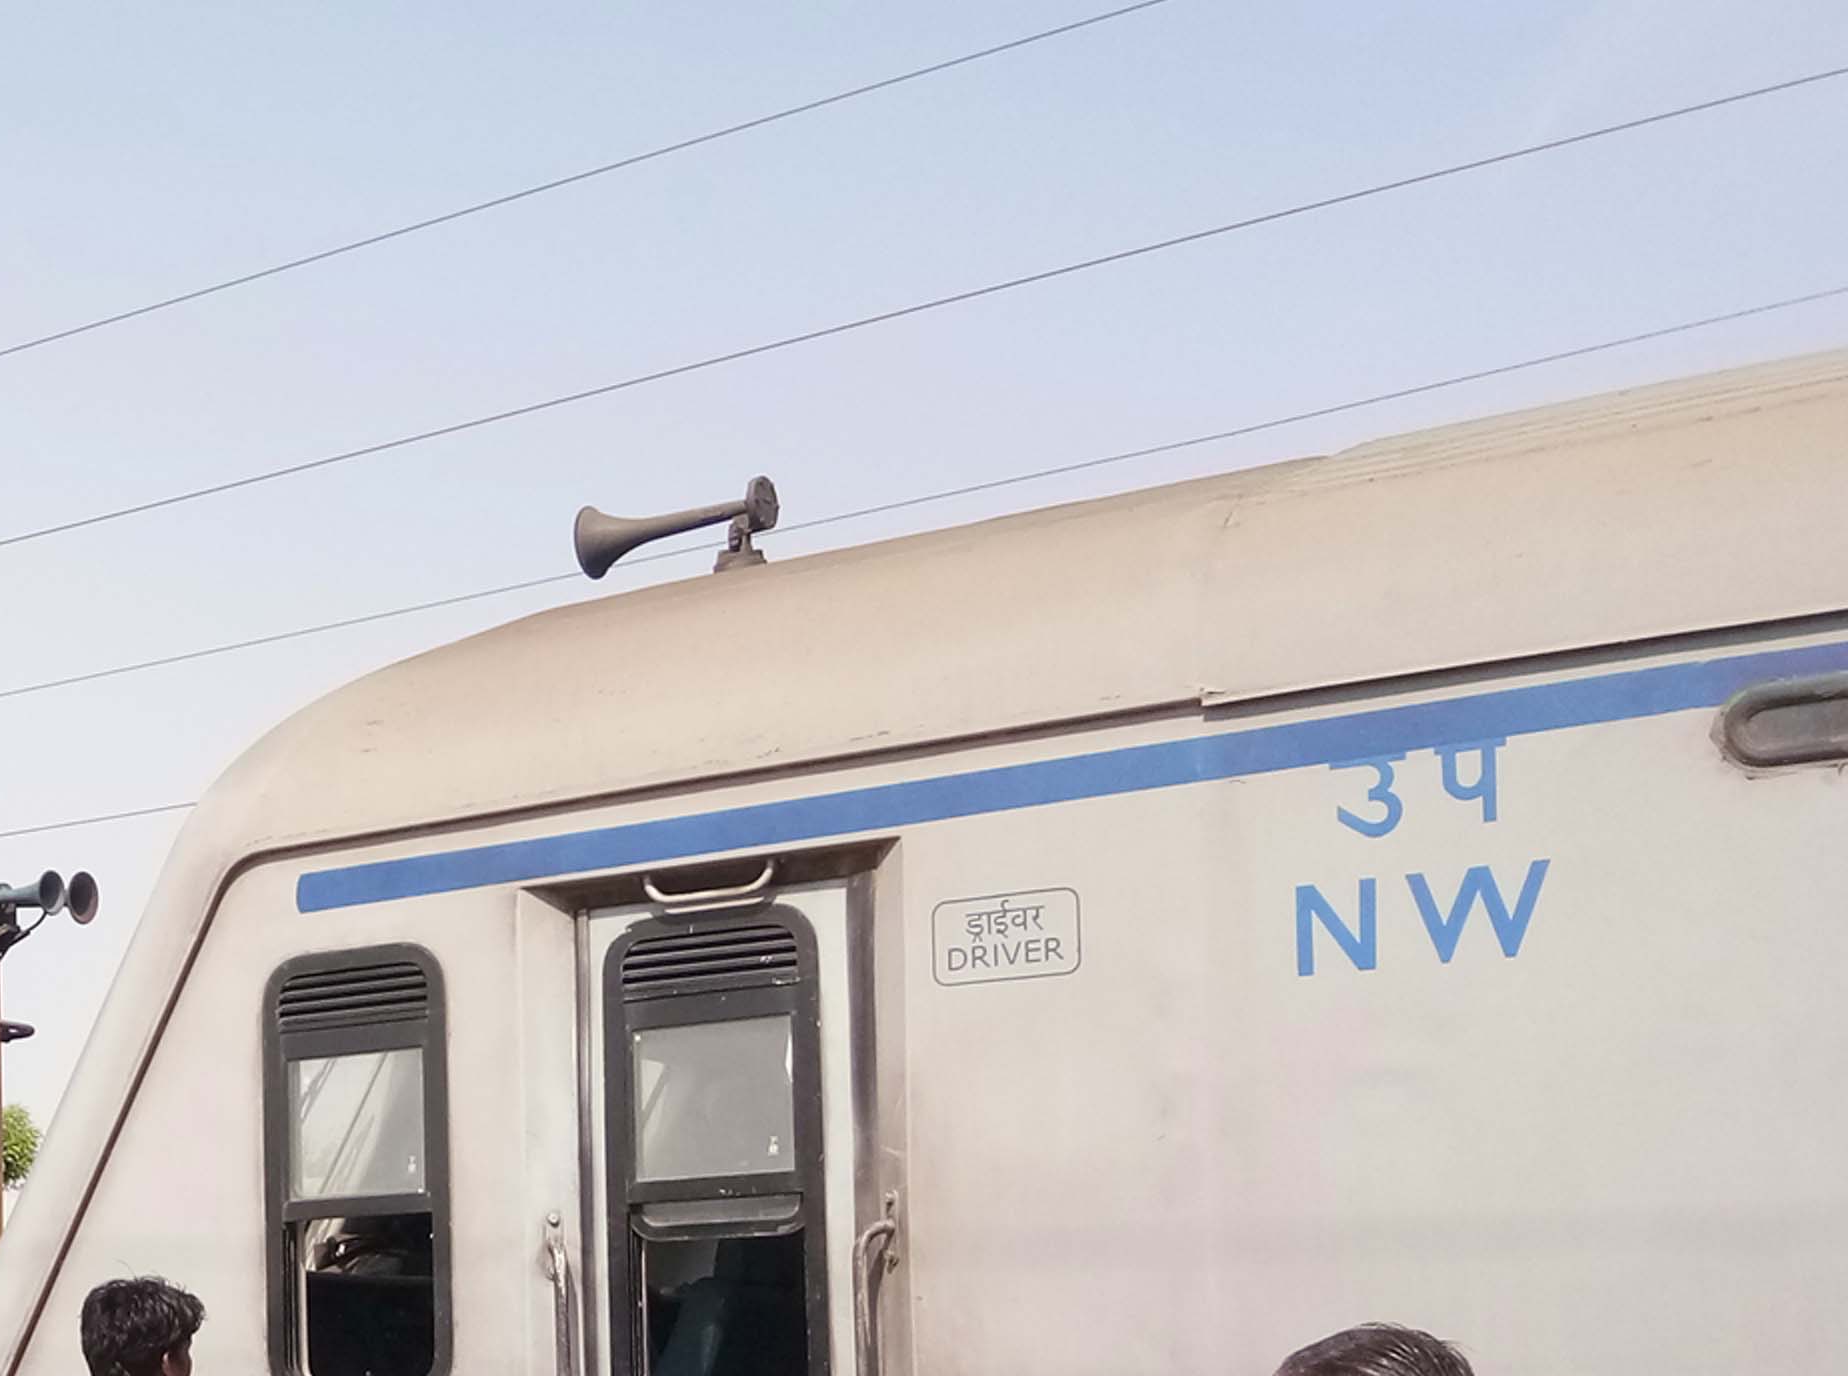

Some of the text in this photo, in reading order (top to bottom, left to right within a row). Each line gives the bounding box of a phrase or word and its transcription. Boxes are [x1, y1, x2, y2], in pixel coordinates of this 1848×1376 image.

[965, 899, 1046, 942] ड्राईवर
[1295, 858, 1551, 977] NW
[947, 937, 1065, 972] DRIVER
